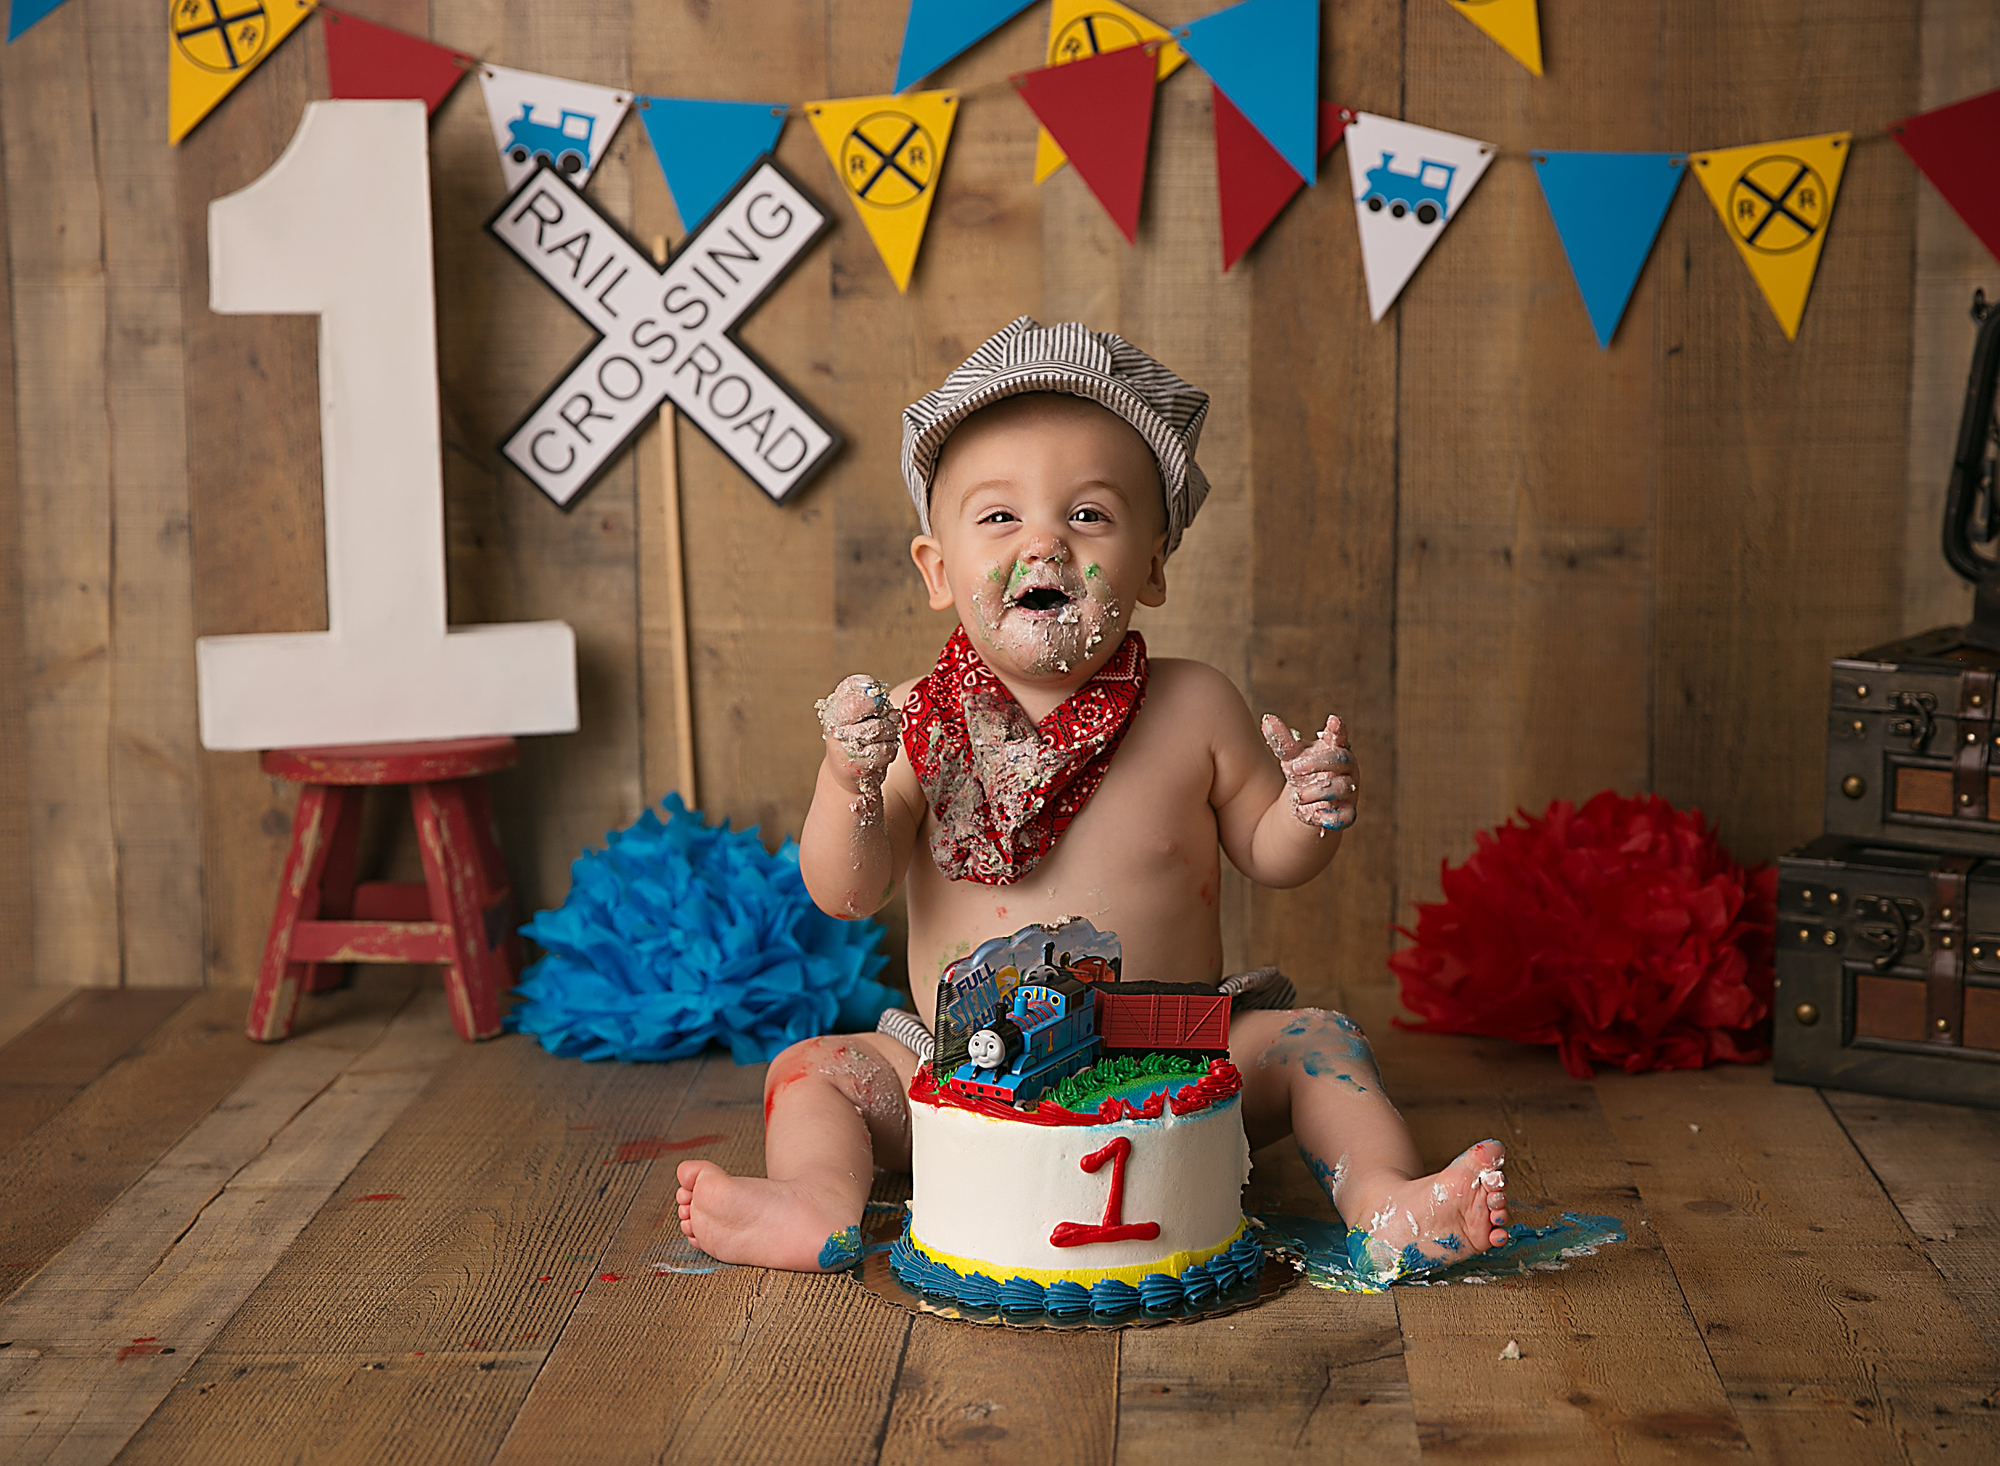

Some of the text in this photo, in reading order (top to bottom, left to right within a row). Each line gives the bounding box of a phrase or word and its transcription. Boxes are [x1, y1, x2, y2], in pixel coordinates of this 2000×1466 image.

[181, 0, 257, 46] R R
[851, 147, 926, 174] R R
[1739, 189, 1815, 218] R R
[512, 189, 809, 474] RAIL ROAD
[529, 192, 794, 476] CROSSING
[197, 100, 578, 750] 1
[948, 975, 1001, 1032] STEAM
[955, 962, 997, 998] FULL
[1046, 1029, 1054, 1054] 1
[1049, 1135, 1161, 1248] 1
